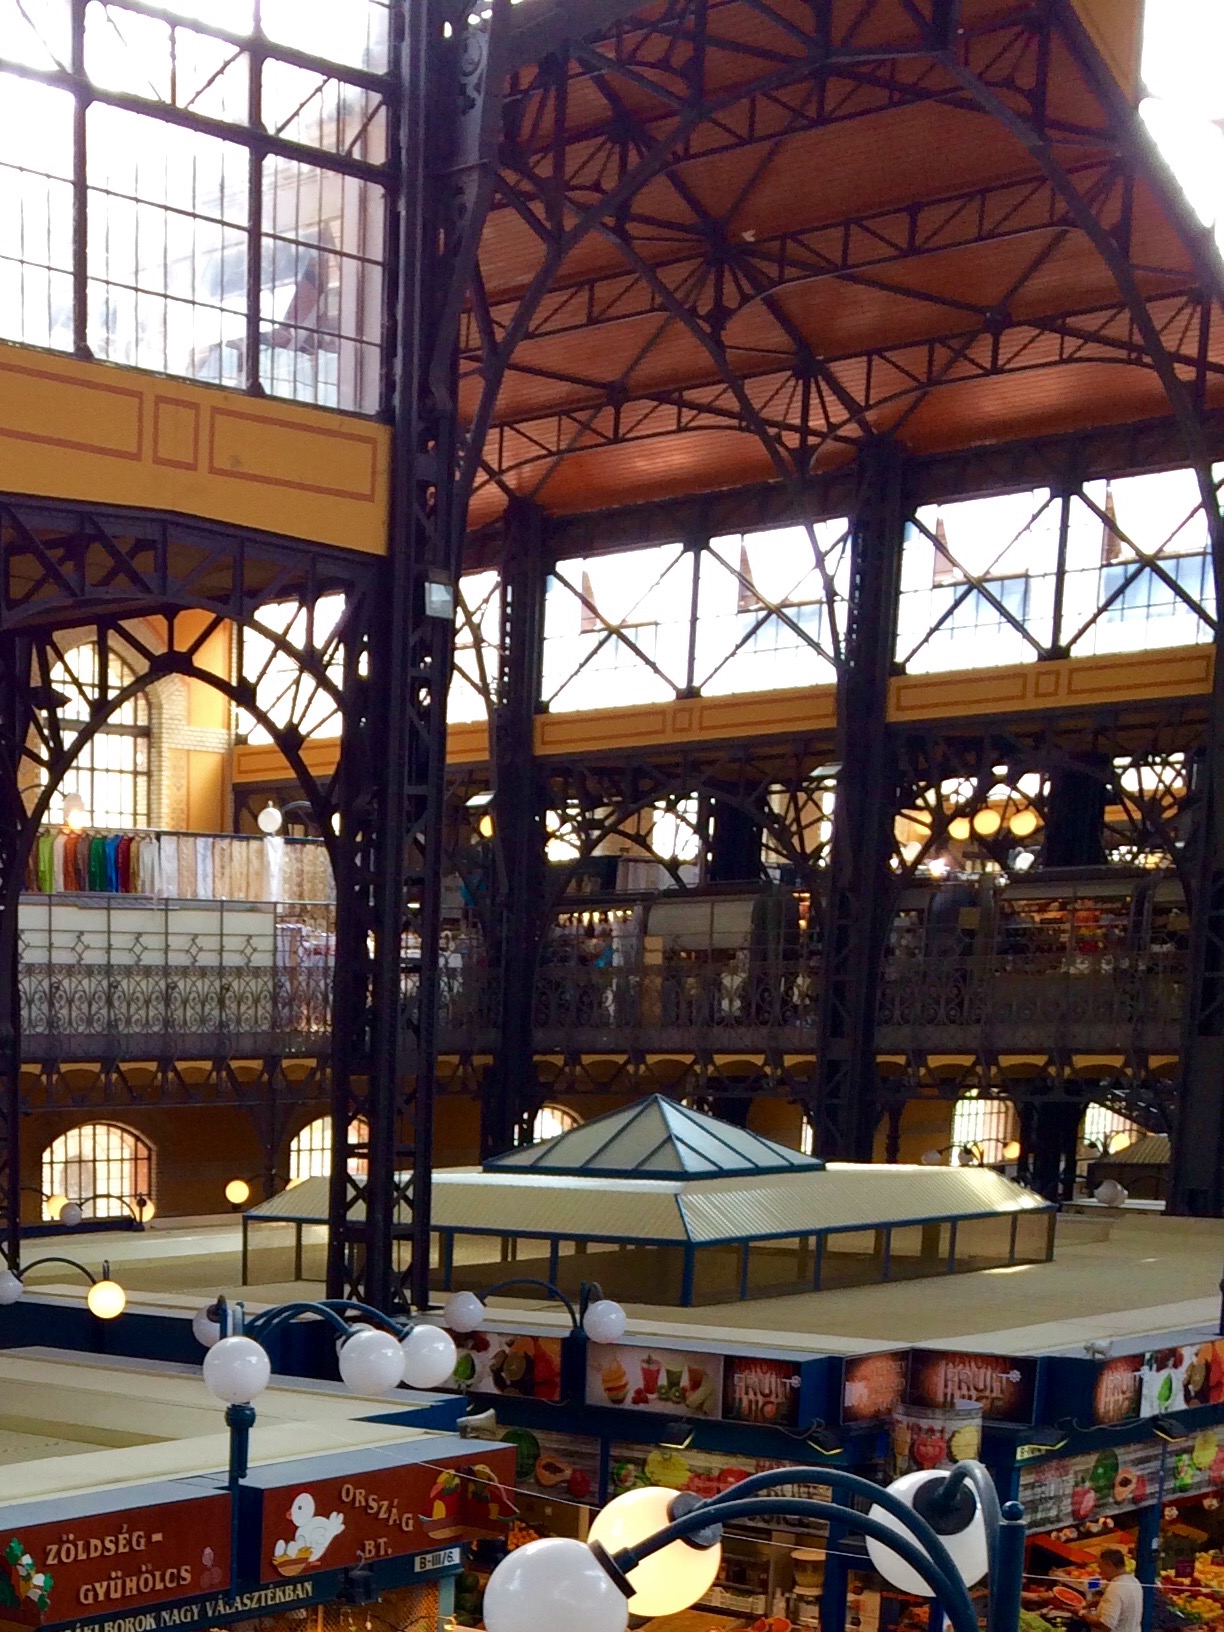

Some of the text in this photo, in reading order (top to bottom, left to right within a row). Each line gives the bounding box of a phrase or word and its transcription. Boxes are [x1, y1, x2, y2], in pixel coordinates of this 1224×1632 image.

[341, 1483, 414, 1532] ORSZÁG
[364, 1537, 393, 1559] BT.
[160, 1603, 202, 1628] NAGY
